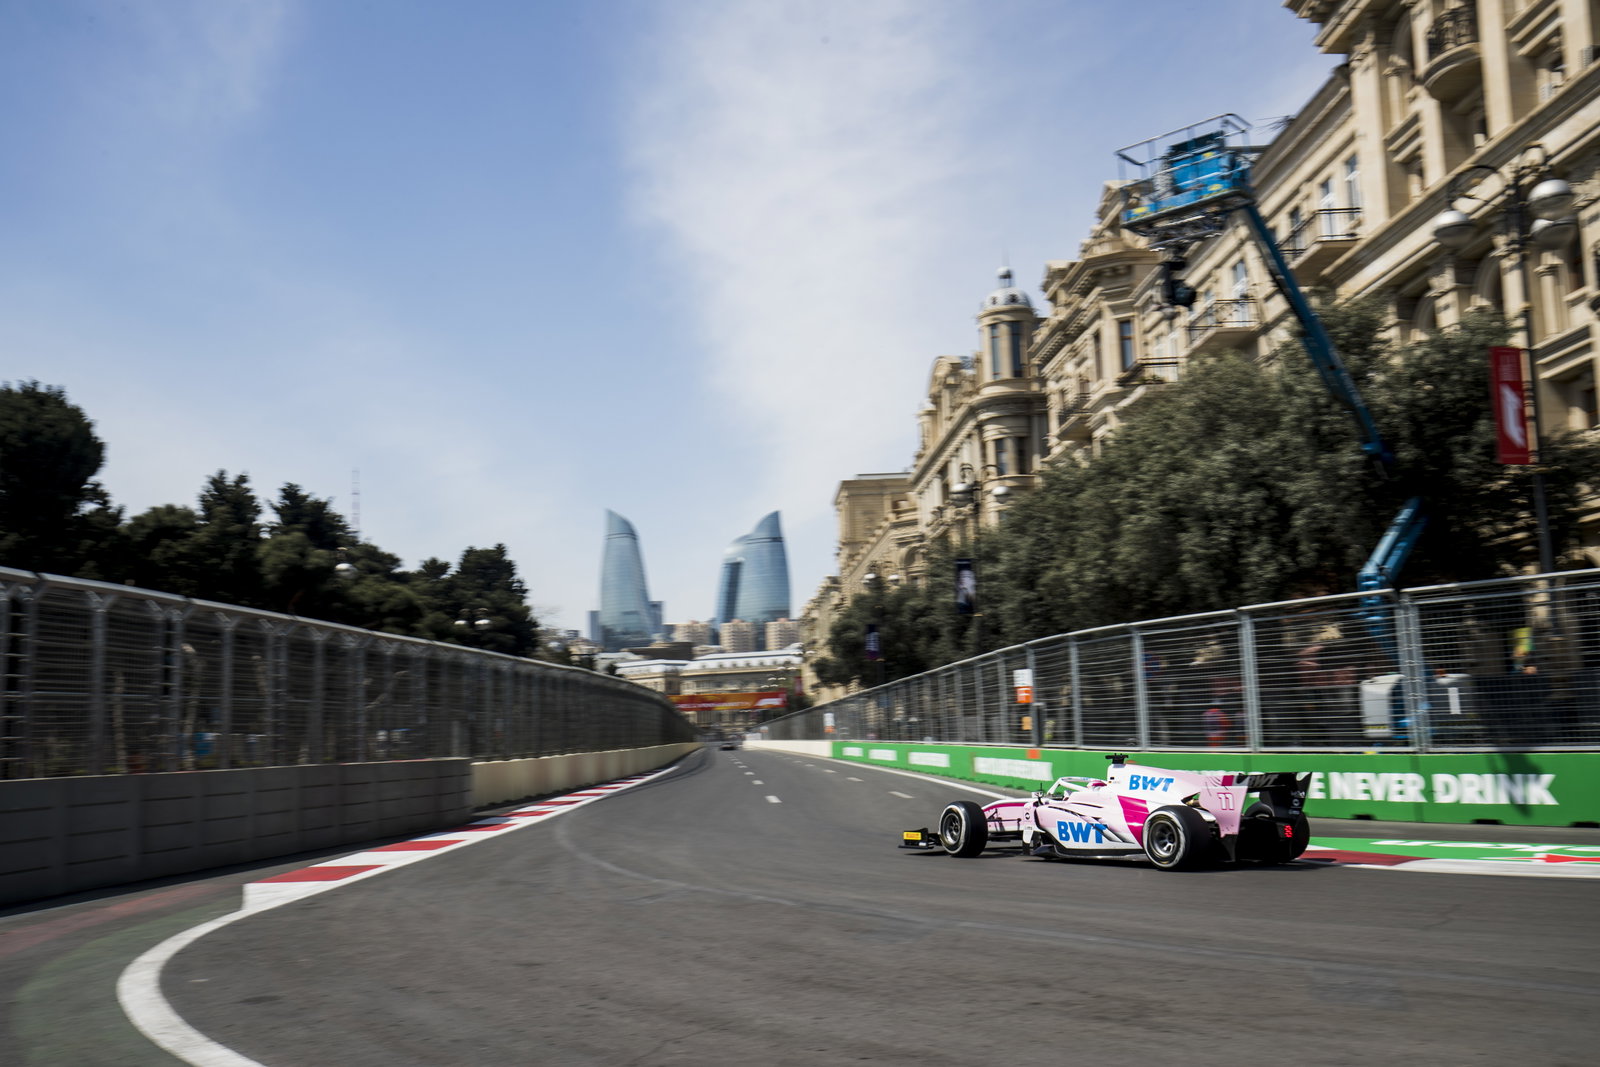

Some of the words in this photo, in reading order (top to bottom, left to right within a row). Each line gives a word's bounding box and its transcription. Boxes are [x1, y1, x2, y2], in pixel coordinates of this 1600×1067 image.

[1129, 775, 1174, 792] BWT
[1328, 772, 1427, 803] NEVER
[1431, 773, 1559, 806] DRINK
[1217, 792, 1234, 811] 11
[1057, 821, 1108, 844] BWT
